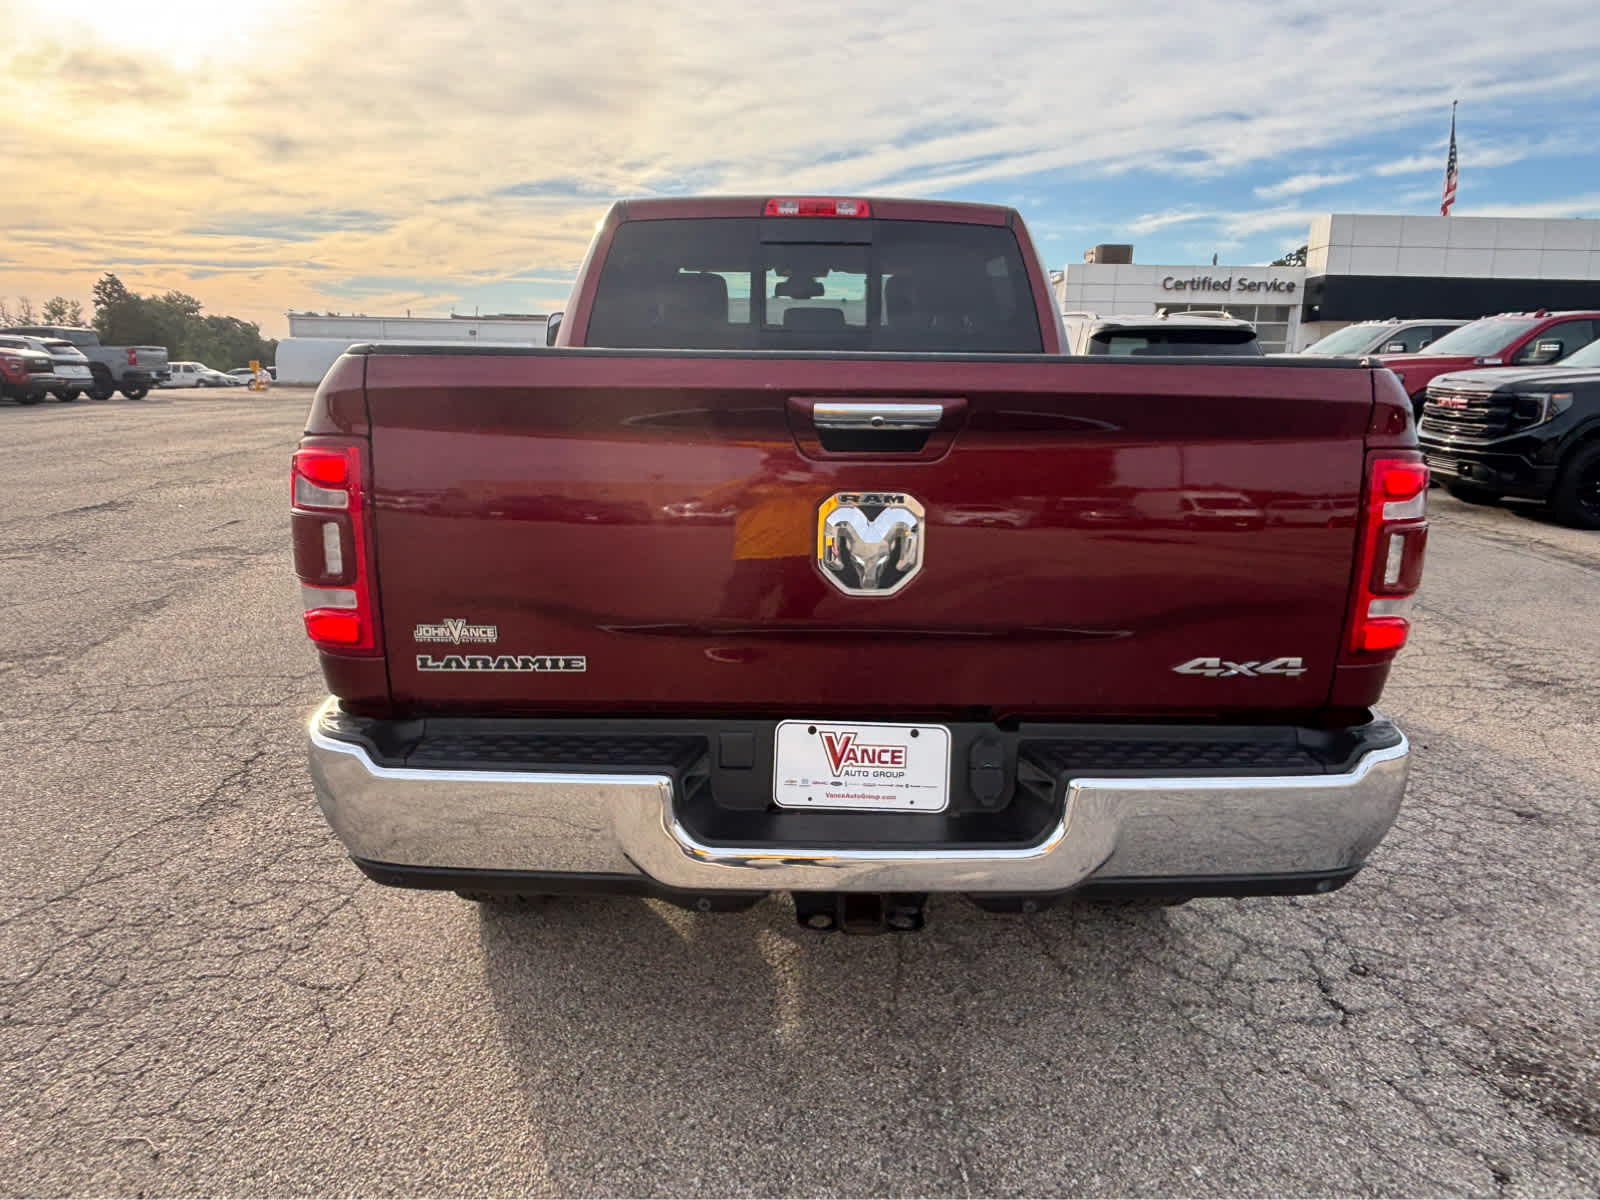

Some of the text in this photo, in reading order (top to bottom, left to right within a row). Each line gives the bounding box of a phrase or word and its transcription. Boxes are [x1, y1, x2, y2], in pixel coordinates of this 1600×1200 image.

[1162, 276, 1297, 293] Certified Service
[840, 494, 905, 504] RAM
[416, 655, 587, 672] LARAMIE
[1172, 657, 1307, 677] 4x4
[822, 733, 904, 773] VANCE
[843, 769, 905, 779] AUTO GROUP
[825, 791, 897, 801] VanceAutoGroup.com
